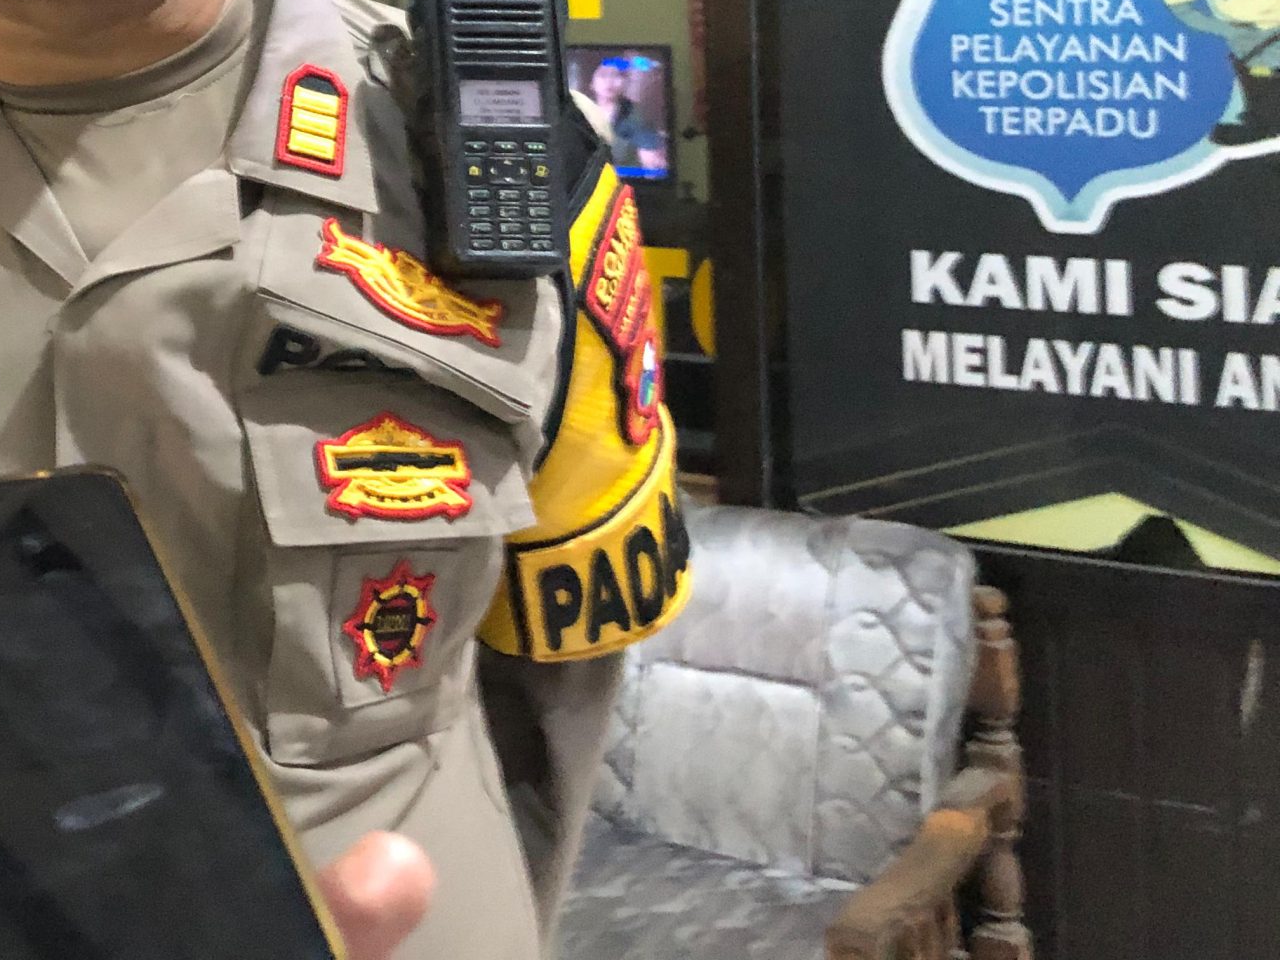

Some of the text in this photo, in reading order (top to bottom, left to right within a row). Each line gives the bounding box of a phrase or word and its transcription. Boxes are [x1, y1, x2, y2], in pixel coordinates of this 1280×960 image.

[950, 32, 1188, 64] PELAYANAN
[951, 69, 1189, 101] KEPOLISIAN
[978, 105, 1159, 139] TERPADU
[908, 248, 1134, 317] KAMI
[901, 328, 1201, 406] MELAYANI
